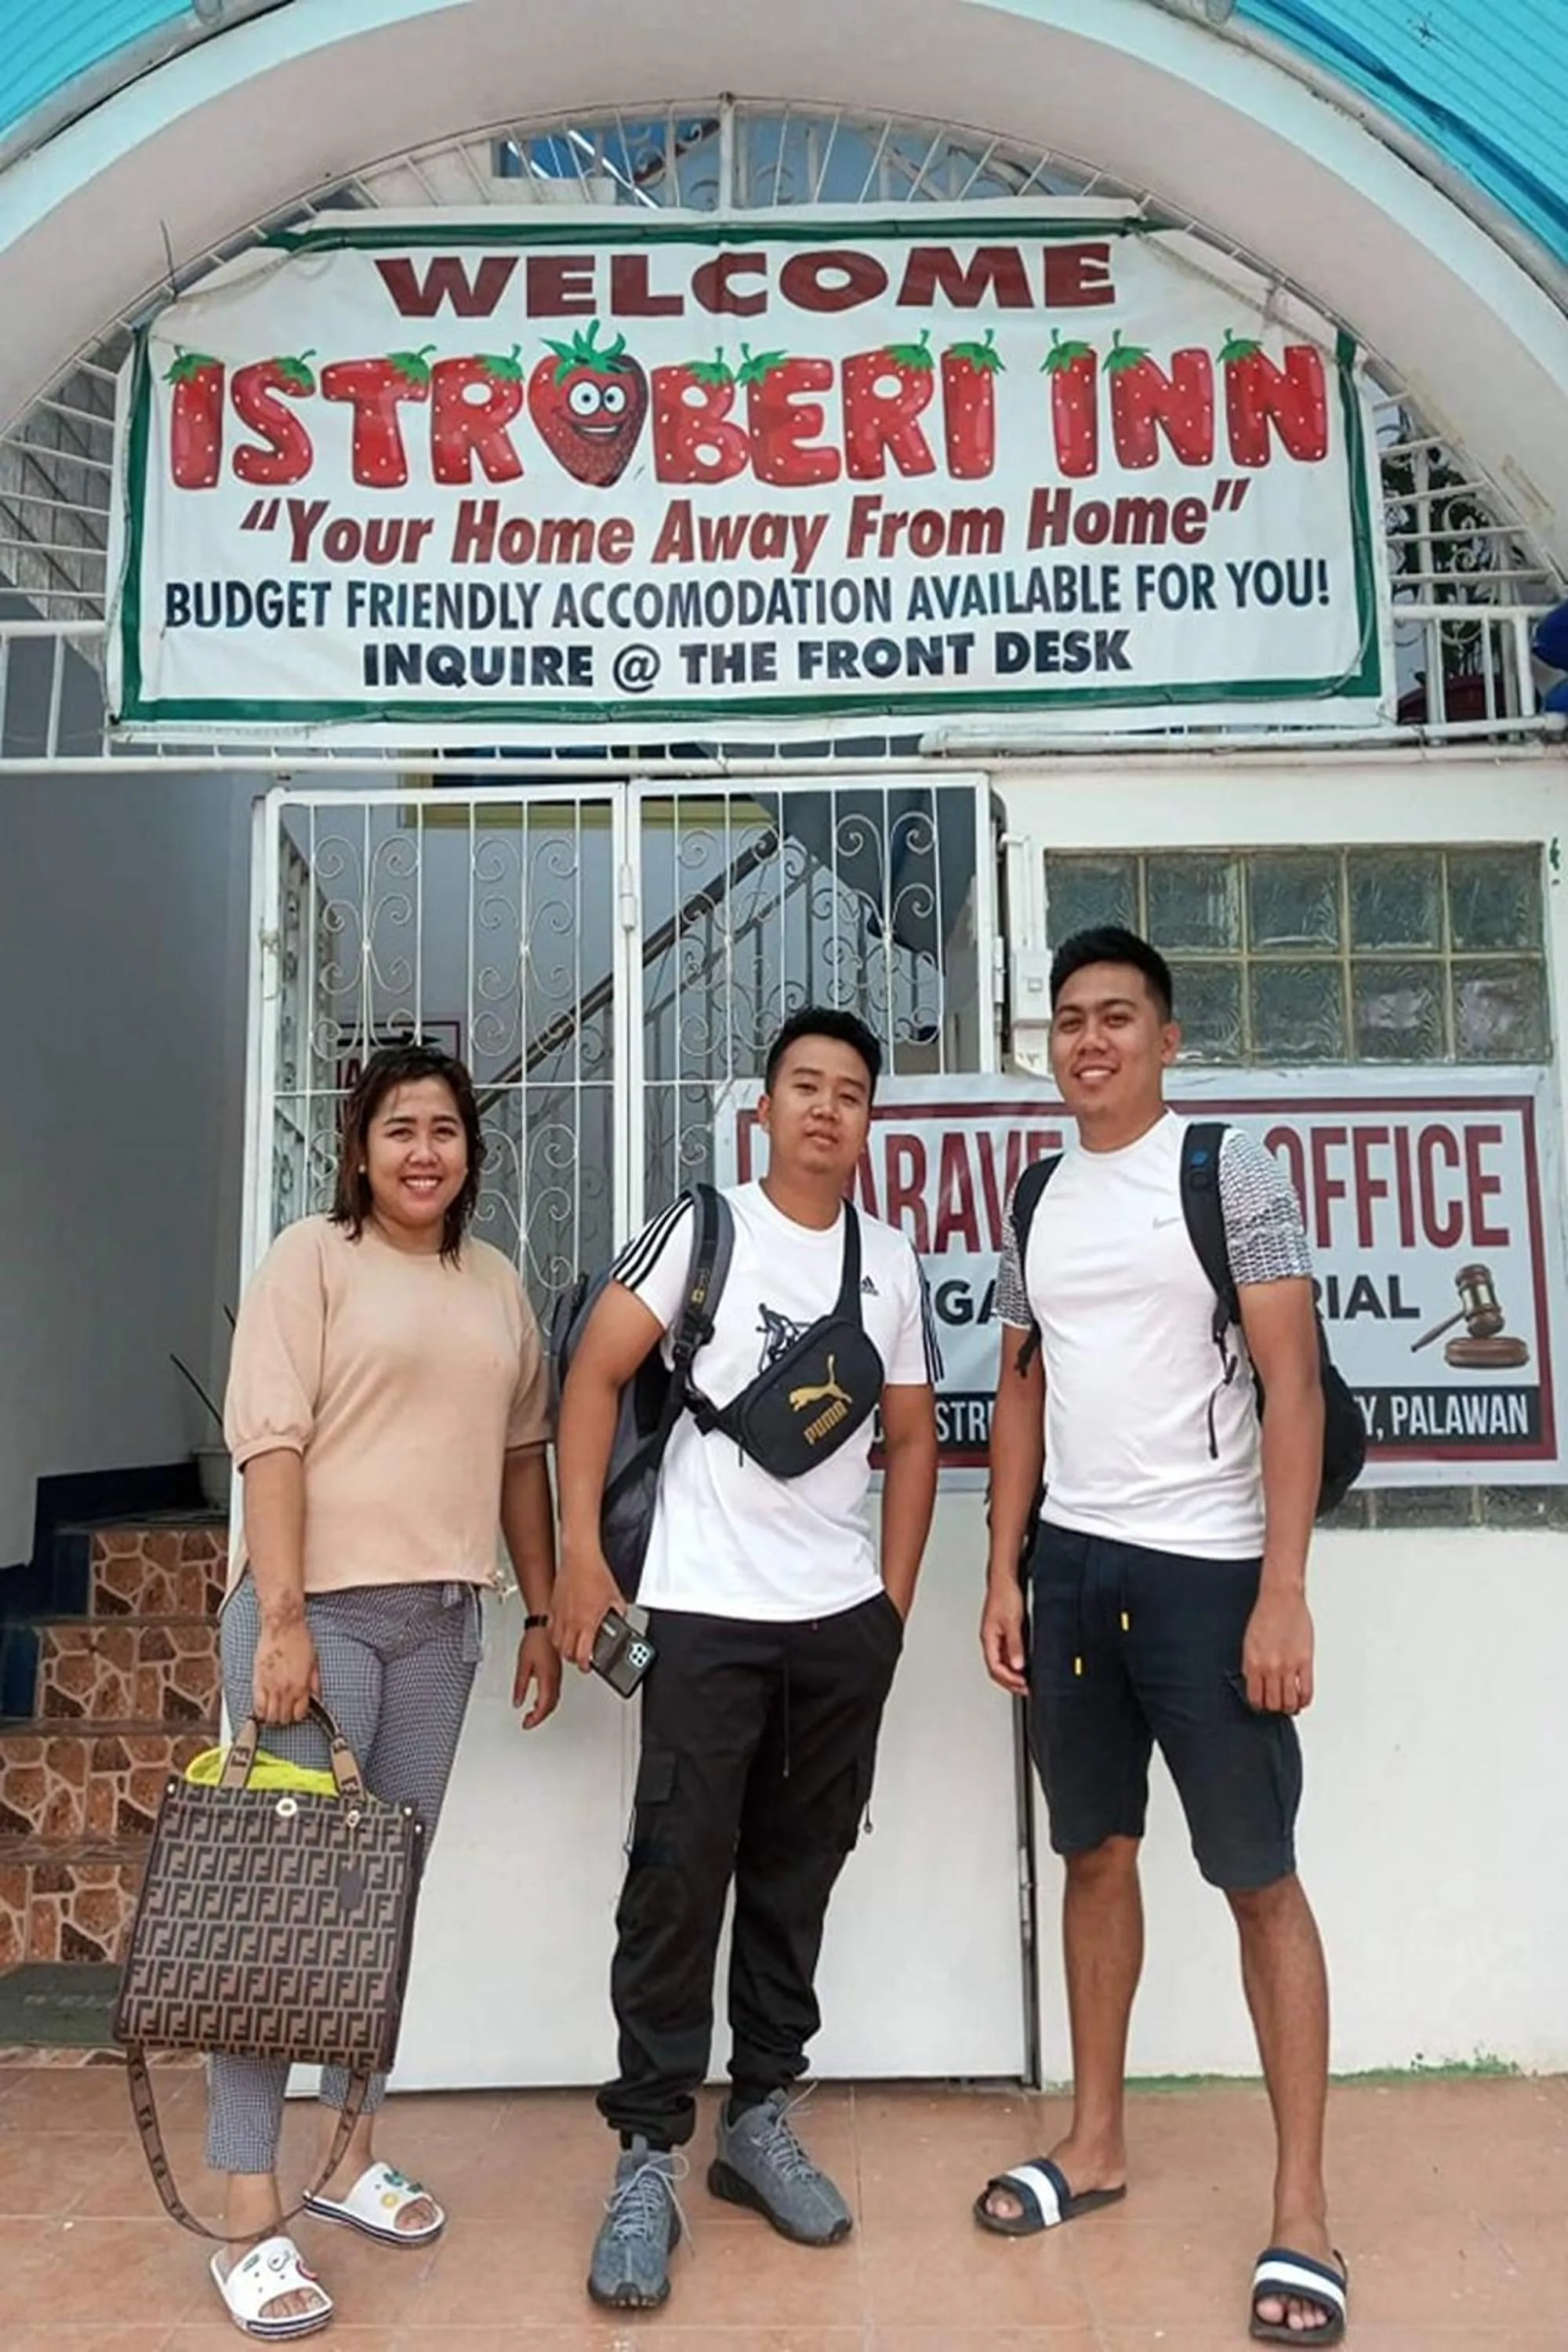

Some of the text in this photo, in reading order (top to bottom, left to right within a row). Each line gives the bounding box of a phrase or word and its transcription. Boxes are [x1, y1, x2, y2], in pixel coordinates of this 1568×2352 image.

[375, 242, 1116, 318] WELCOME
[1040, 328, 1328, 481] INN
[451, 499, 634, 564] Home
[652, 499, 829, 574] Away
[846, 495, 1004, 558] From
[165, 557, 1330, 630] BUDGET FRIENDLY ACCOMODATION AVAILABLE FOR YOU!
[363, 630, 1132, 694] INQUIRE @ THE FRONT DESK
[803, 1400, 848, 1445] PUMA
[1390, 1394, 1529, 1436] PALAWAN
